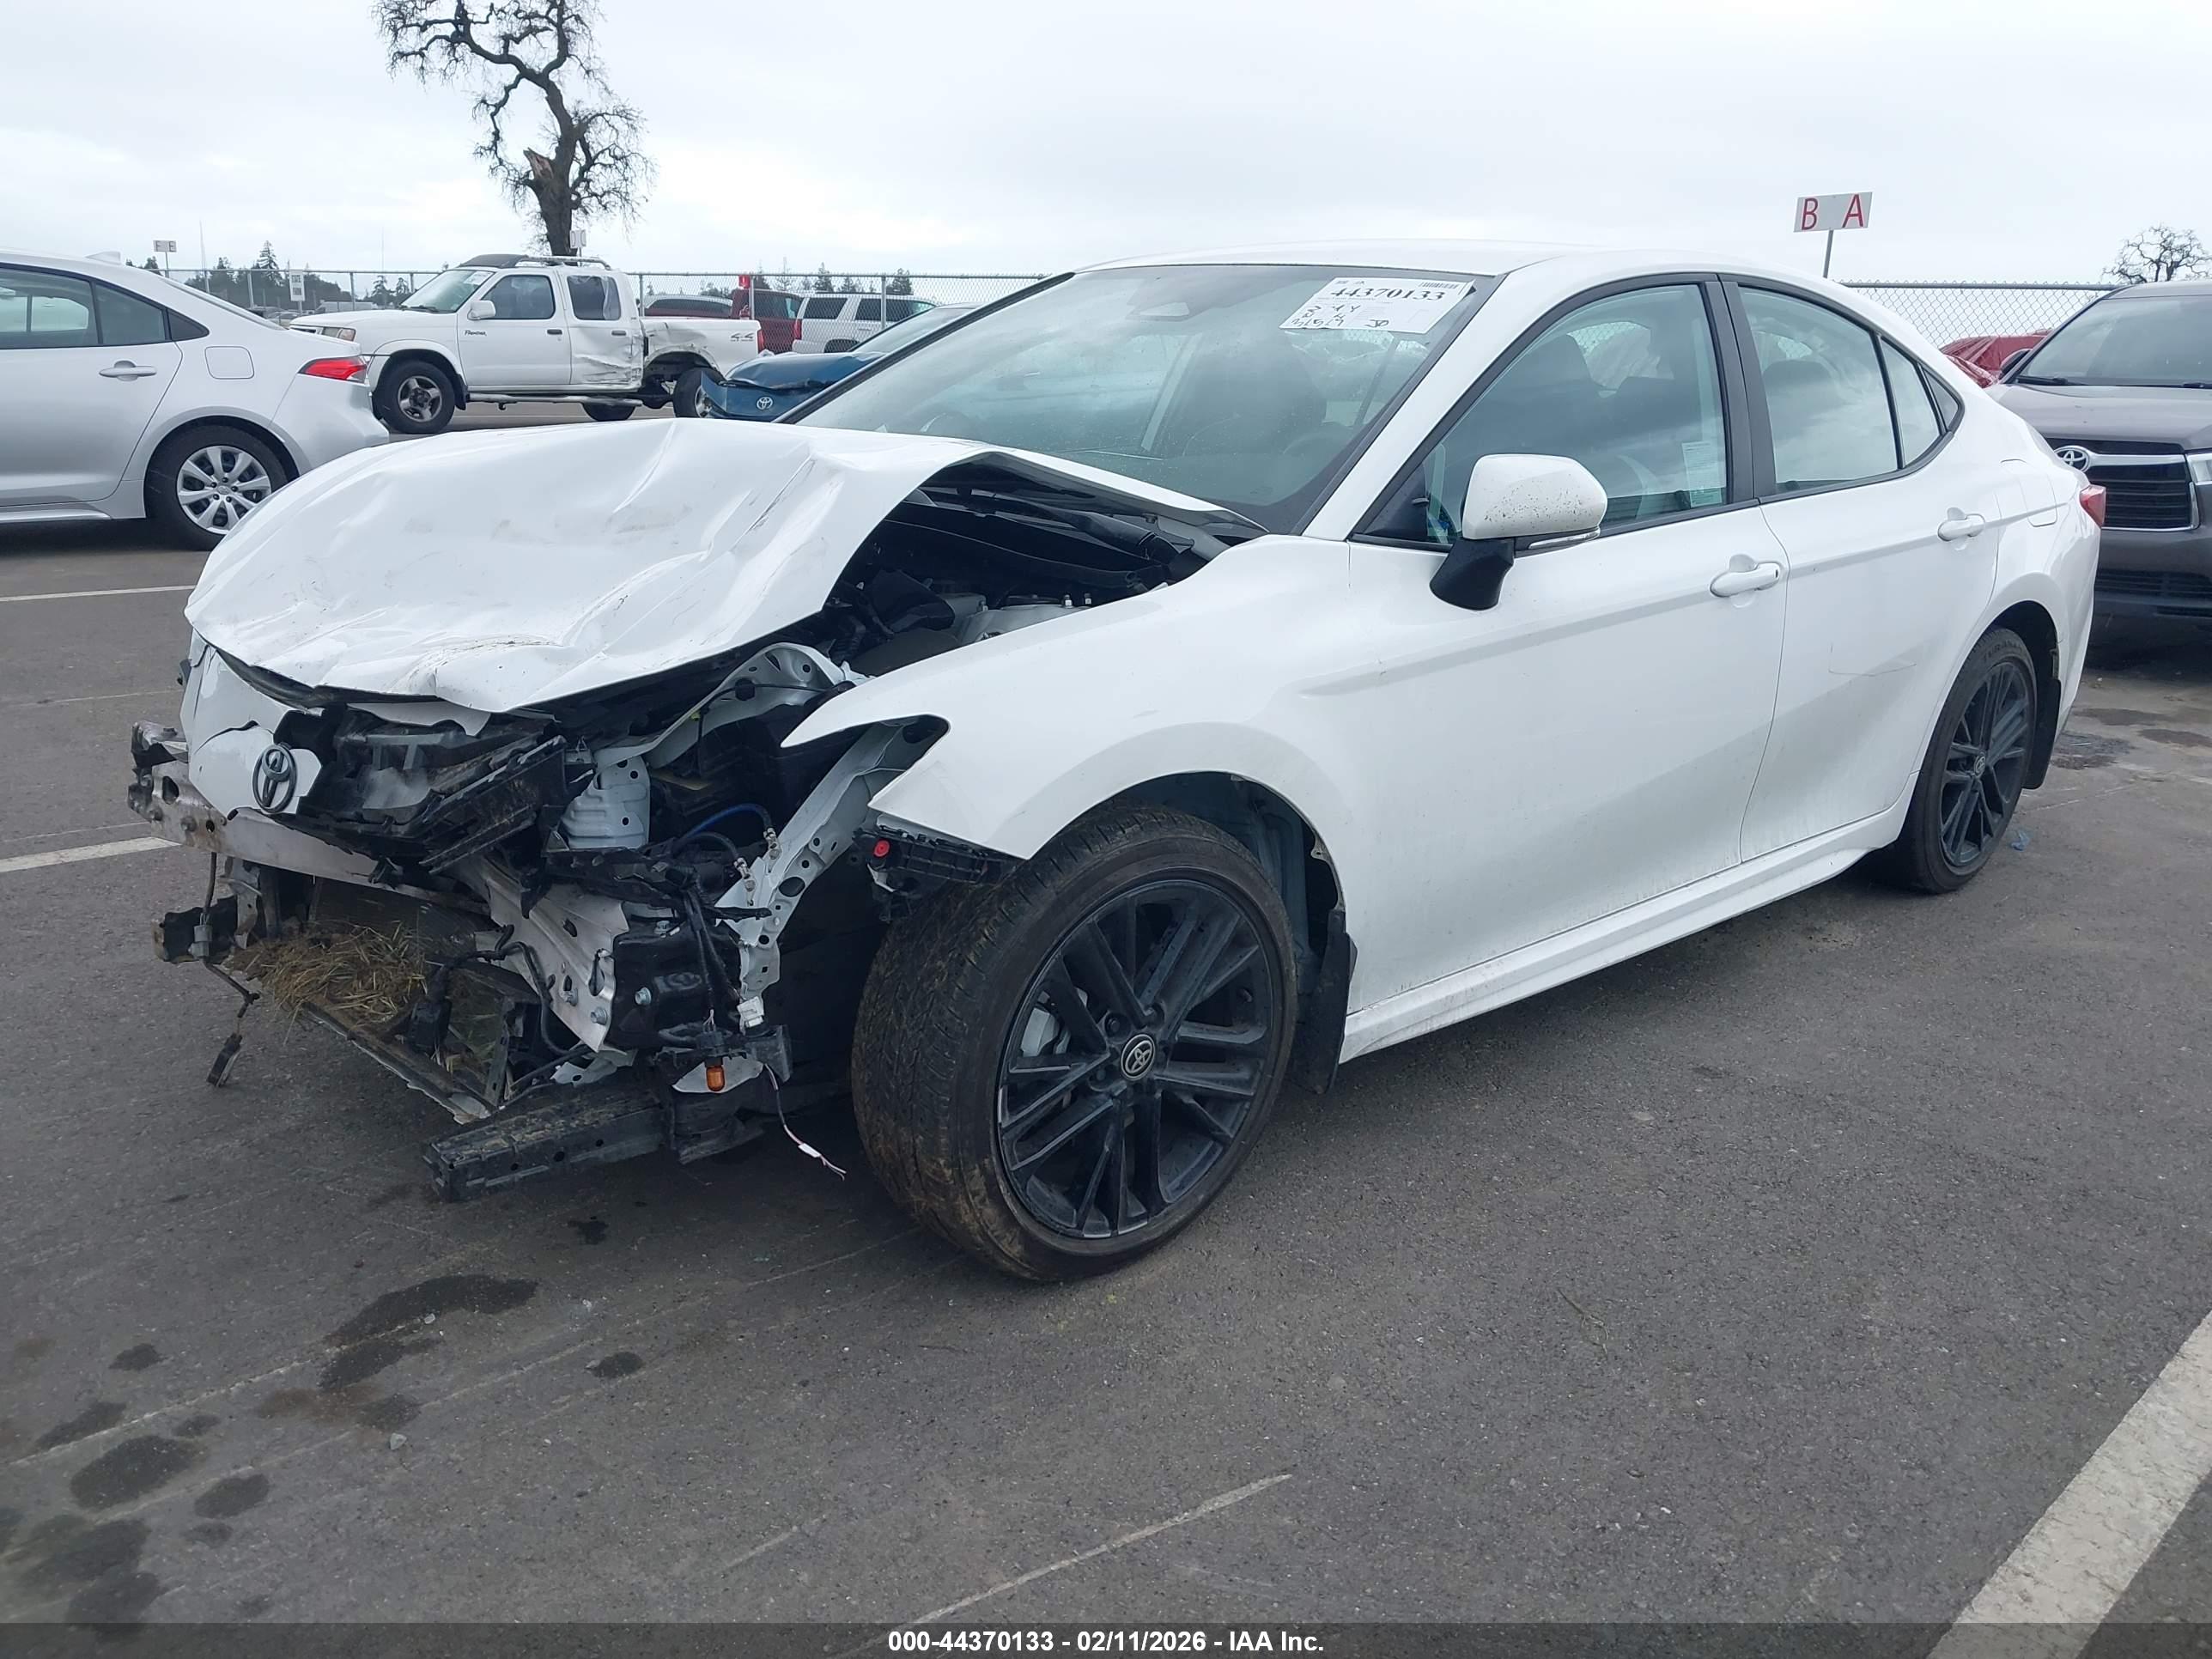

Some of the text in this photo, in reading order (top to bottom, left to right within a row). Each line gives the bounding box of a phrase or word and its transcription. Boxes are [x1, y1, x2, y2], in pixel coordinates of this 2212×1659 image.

[1801, 193, 1864, 231] B A
[168, 240, 175, 252] E
[1330, 288, 1445, 301] 44370133
